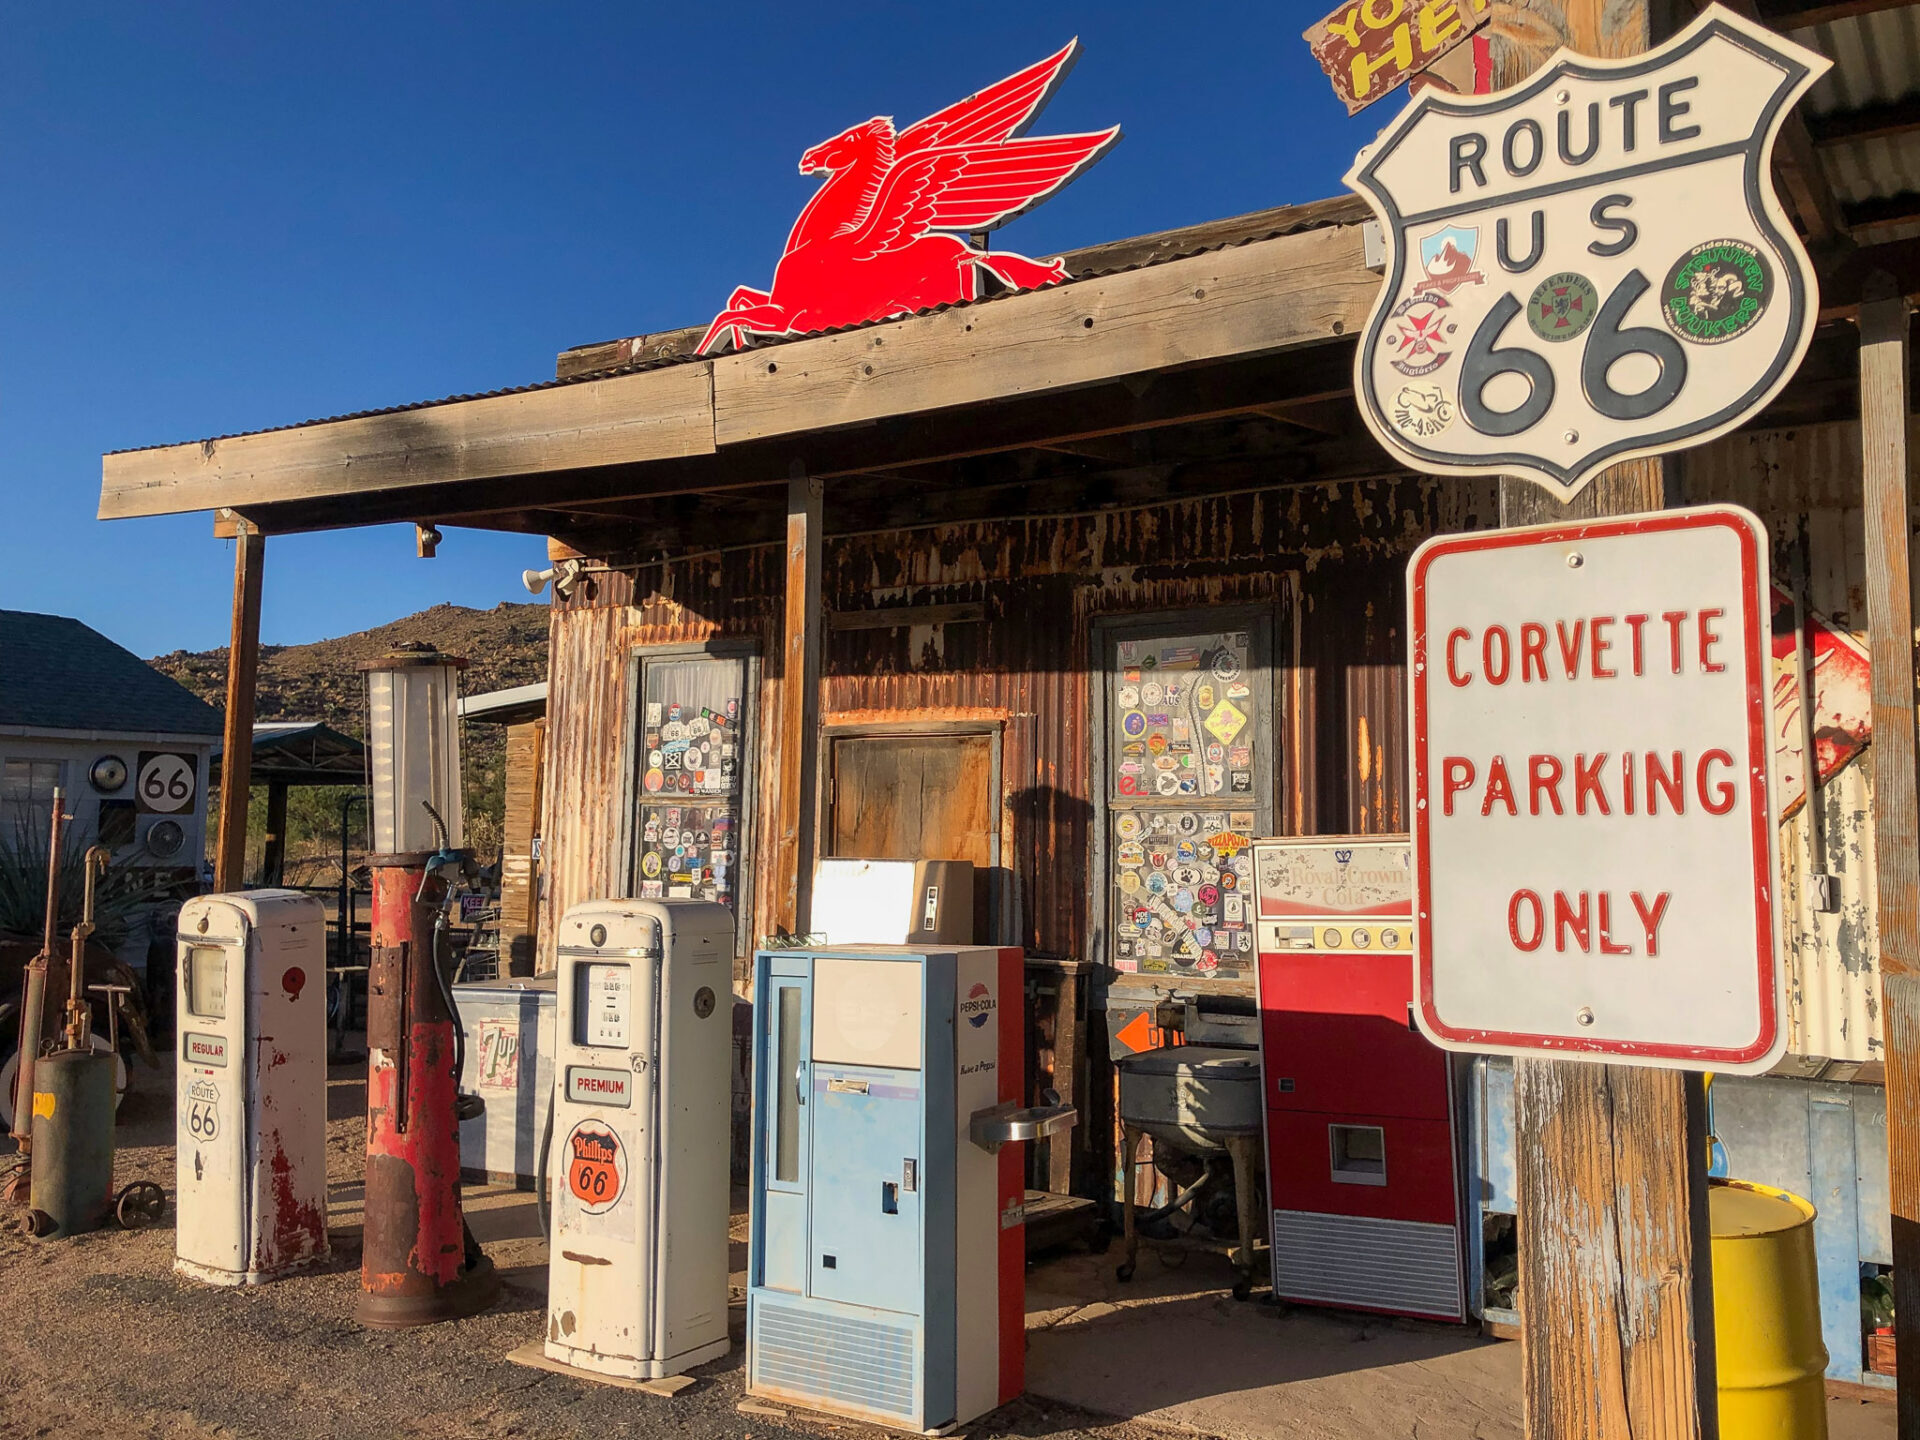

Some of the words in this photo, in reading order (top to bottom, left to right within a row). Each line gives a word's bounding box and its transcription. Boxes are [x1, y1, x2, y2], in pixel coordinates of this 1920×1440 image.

[1449, 76, 1701, 193] ROUTE
[1691, 240, 1758, 257] Oldebroek
[1530, 274, 1593, 305] DEFENDERS
[1458, 268, 1688, 437] 66
[1447, 608, 1725, 687] CORVETTE
[144, 767, 188, 800] 66
[1442, 748, 1736, 817] PARKING
[1292, 867, 1339, 885] Royal
[1347, 867, 1404, 884] Crown
[1323, 888, 1365, 905] Cola
[1508, 888, 1671, 957] ONLY
[960, 1000, 996, 1012] PEPSI-COLA
[192, 1041, 224, 1057] REGULAR
[980, 1060, 996, 1072] Pepsi
[191, 1083, 215, 1100] ROUTE
[577, 1077, 624, 1095] PREMIUM
[190, 1102, 215, 1136] 66
[574, 1136, 613, 1166] Phillips
[579, 1166, 608, 1196] 66
